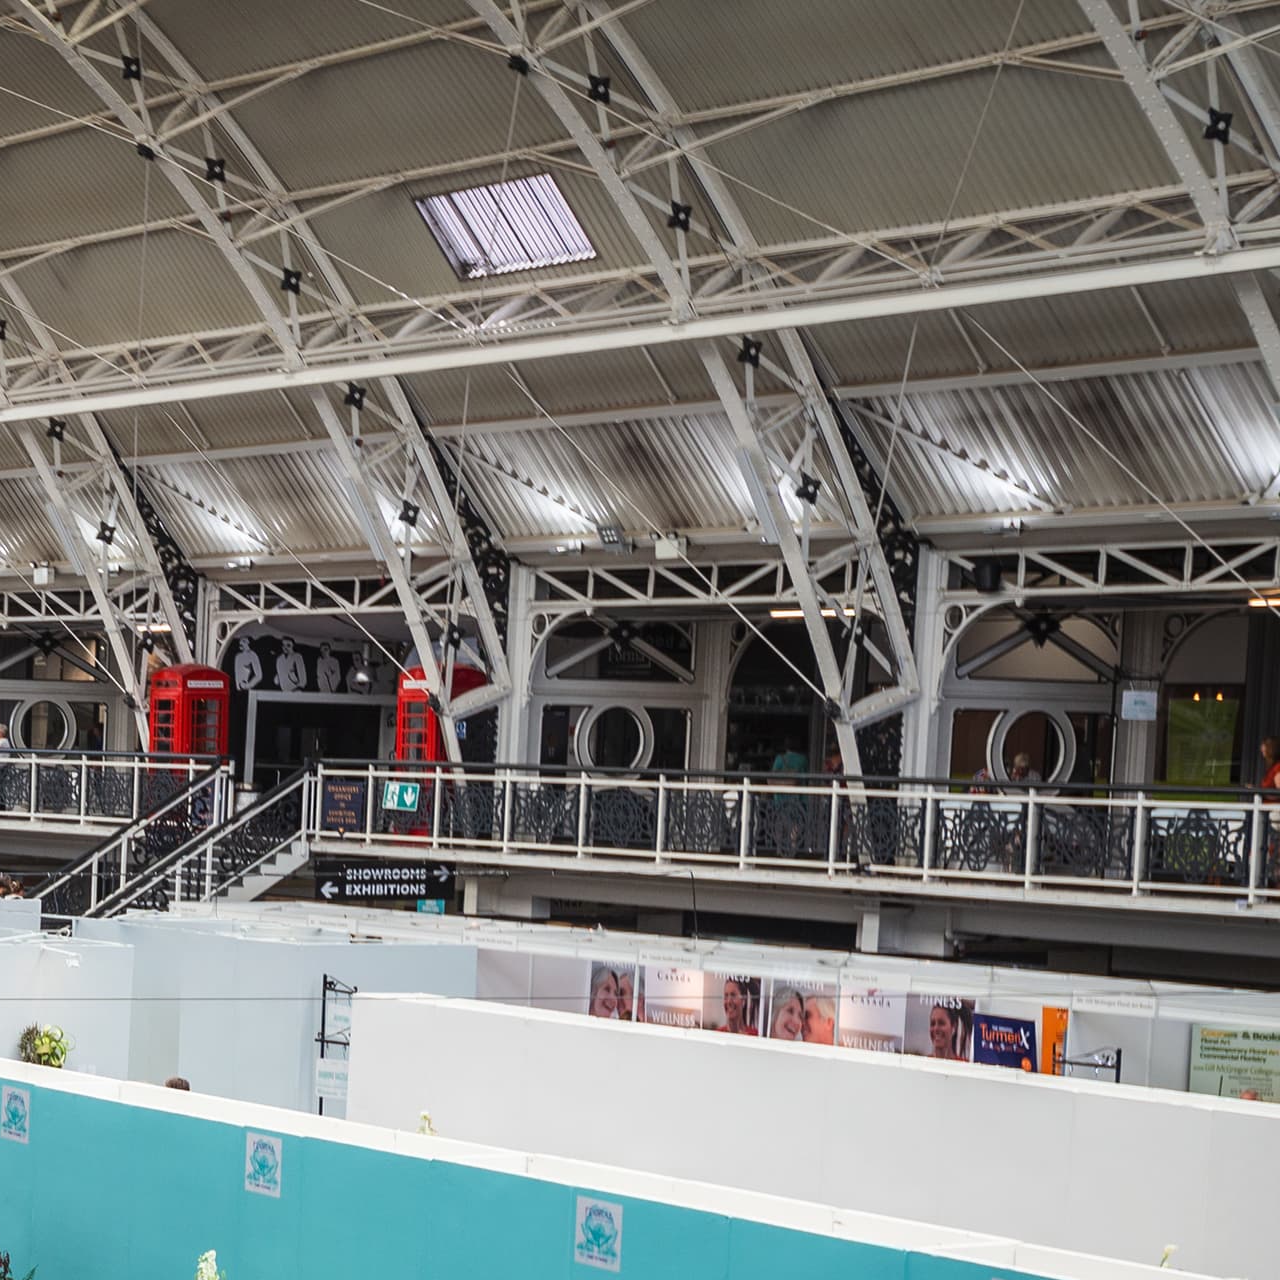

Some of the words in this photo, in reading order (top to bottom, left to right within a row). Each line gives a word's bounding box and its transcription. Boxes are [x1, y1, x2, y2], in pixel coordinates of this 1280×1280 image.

[345, 867, 427, 881] SHOWROOMS
[345, 882, 427, 896] EXHIBITIONS
[919, 994, 963, 1010] FITNESS
[651, 1009, 697, 1026] WELLNESS
[841, 1035, 896, 1054] WELLNESS
